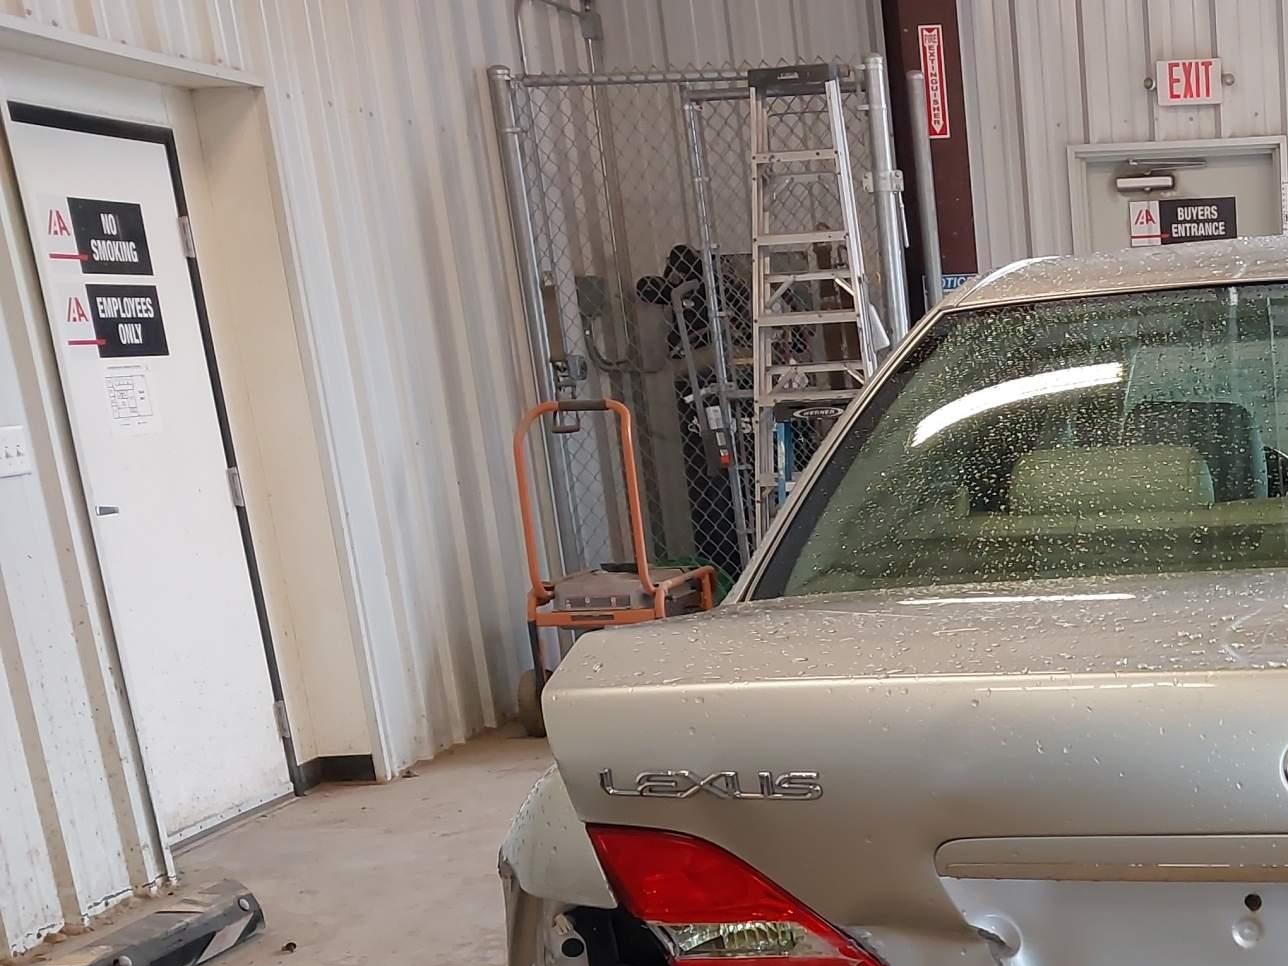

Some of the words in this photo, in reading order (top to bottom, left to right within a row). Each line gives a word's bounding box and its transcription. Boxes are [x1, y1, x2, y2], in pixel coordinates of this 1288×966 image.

[928, 45, 940, 126] EXTINGUISHER
[1168, 61, 1213, 99] EXIT
[100, 213, 118, 235] NO
[1177, 205, 1218, 221] BUYERS
[1171, 221, 1226, 238] ENTRANCE
[90, 239, 139, 262] SMOKING
[96, 297, 155, 318] EMPLOYEES
[118, 323, 143, 345] ONLY
[598, 768, 823, 799] LEXUS
